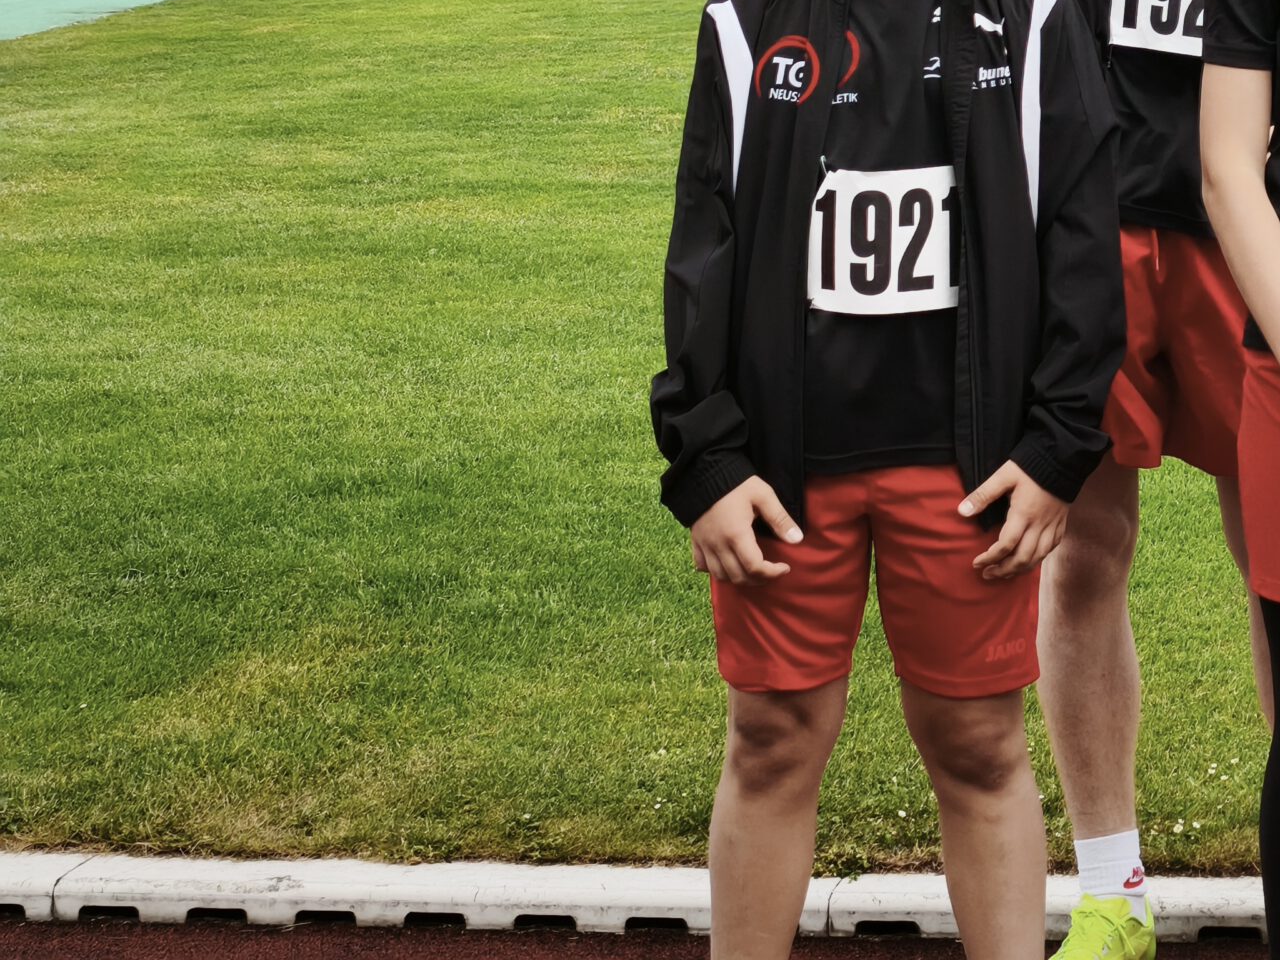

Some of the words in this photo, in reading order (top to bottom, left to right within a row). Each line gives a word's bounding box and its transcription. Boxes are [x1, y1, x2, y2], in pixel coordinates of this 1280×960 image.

[978, 65, 1011, 82] bune
[981, 77, 1012, 89] NEU
[815, 187, 960, 296] 1921
